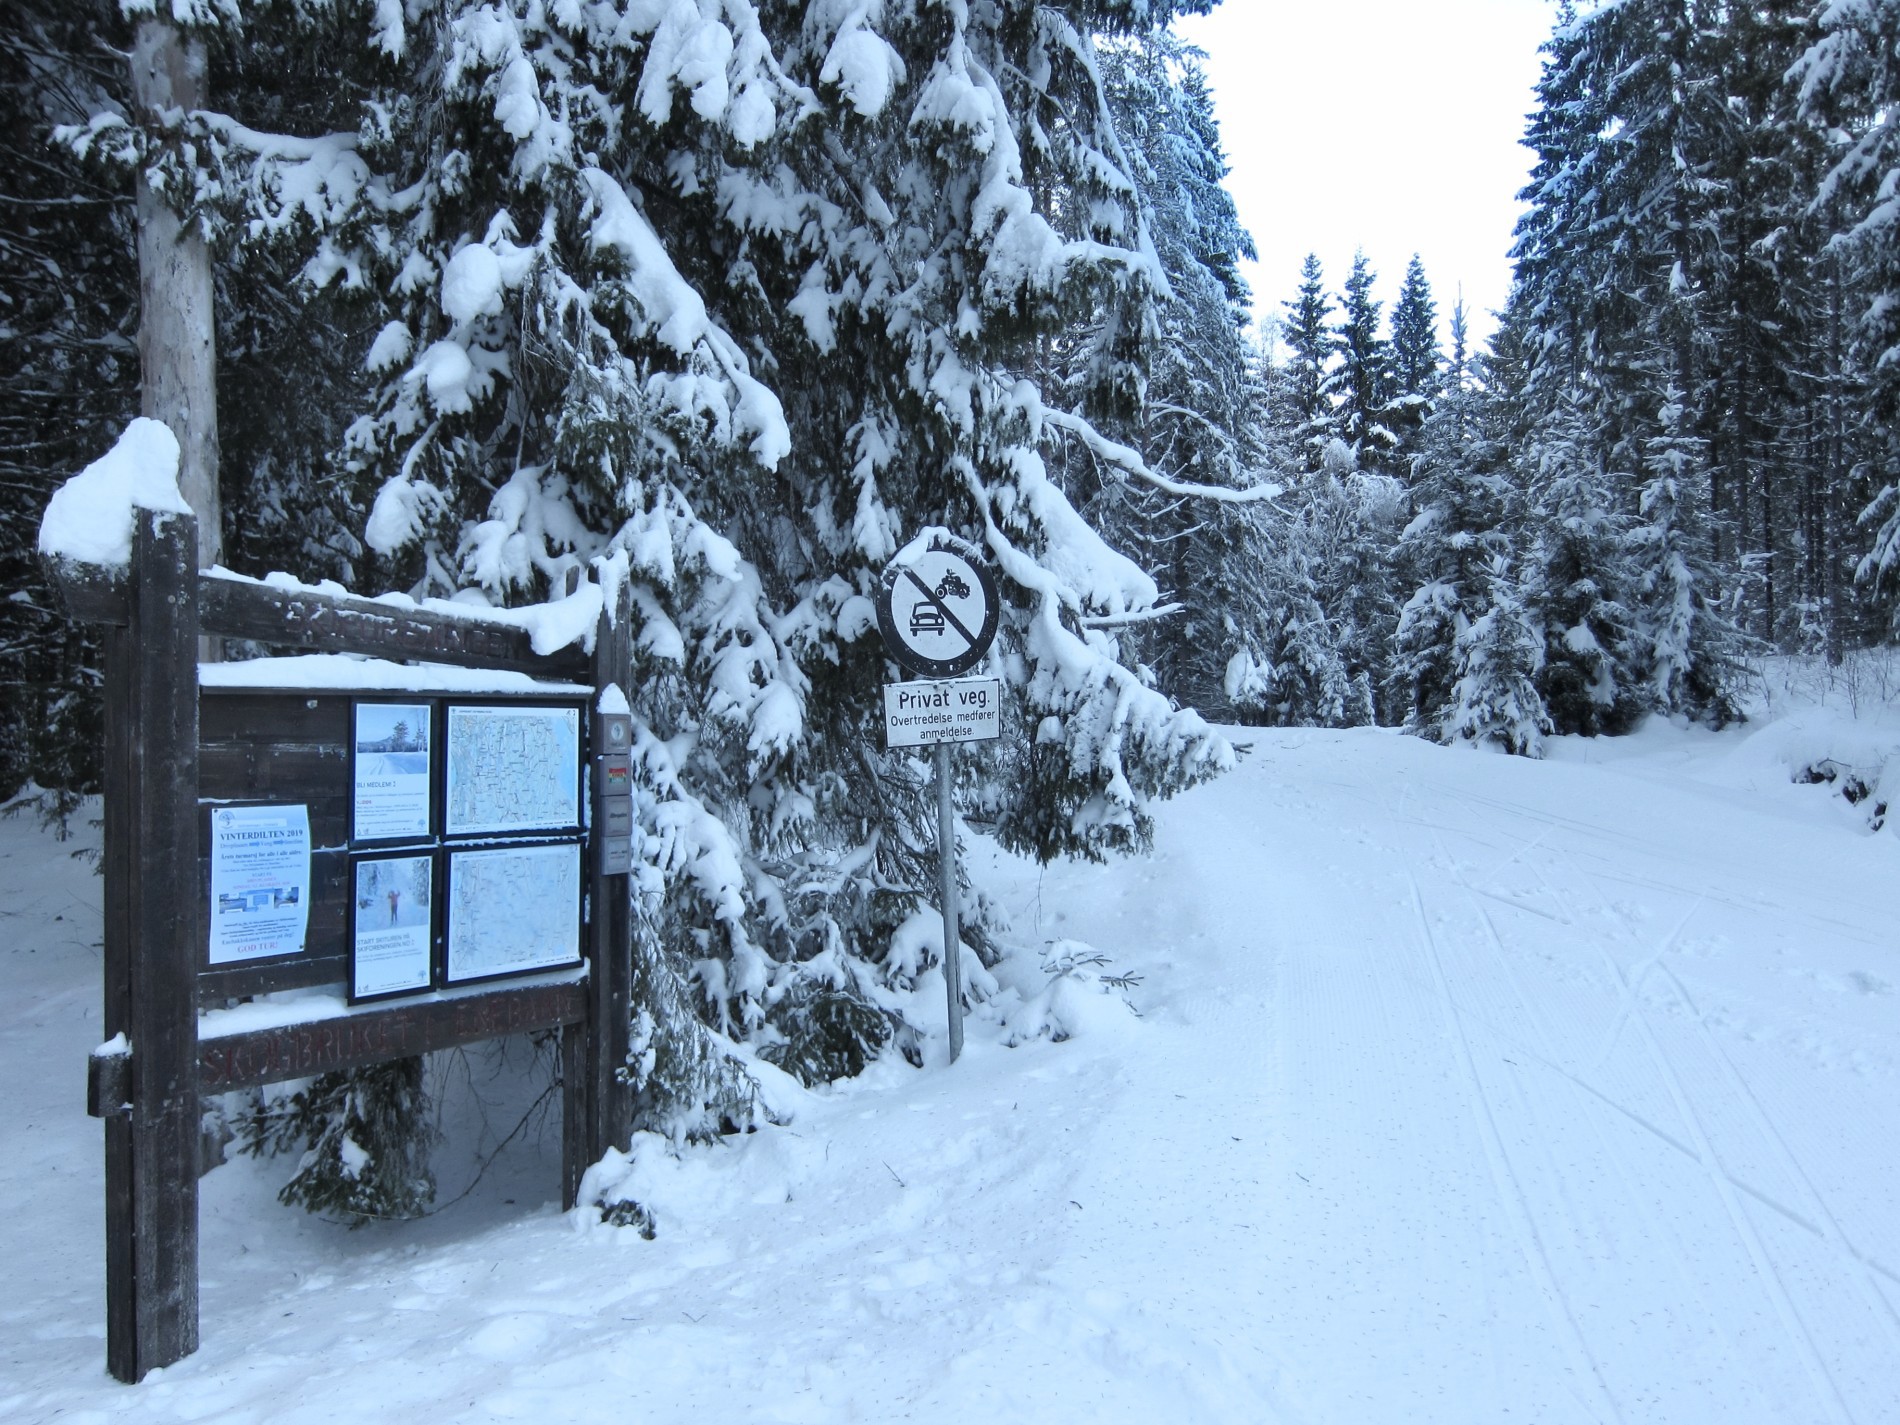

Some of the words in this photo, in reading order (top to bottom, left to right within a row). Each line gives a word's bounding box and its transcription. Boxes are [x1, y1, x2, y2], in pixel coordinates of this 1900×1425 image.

[899, 689, 950, 709] Privat
[959, 689, 991, 708] veg.
[890, 712, 953, 727] Overtredelse
[957, 710, 996, 722] medfører
[220, 830, 285, 841] VINTERDILTEN
[287, 829, 304, 837] 2019
